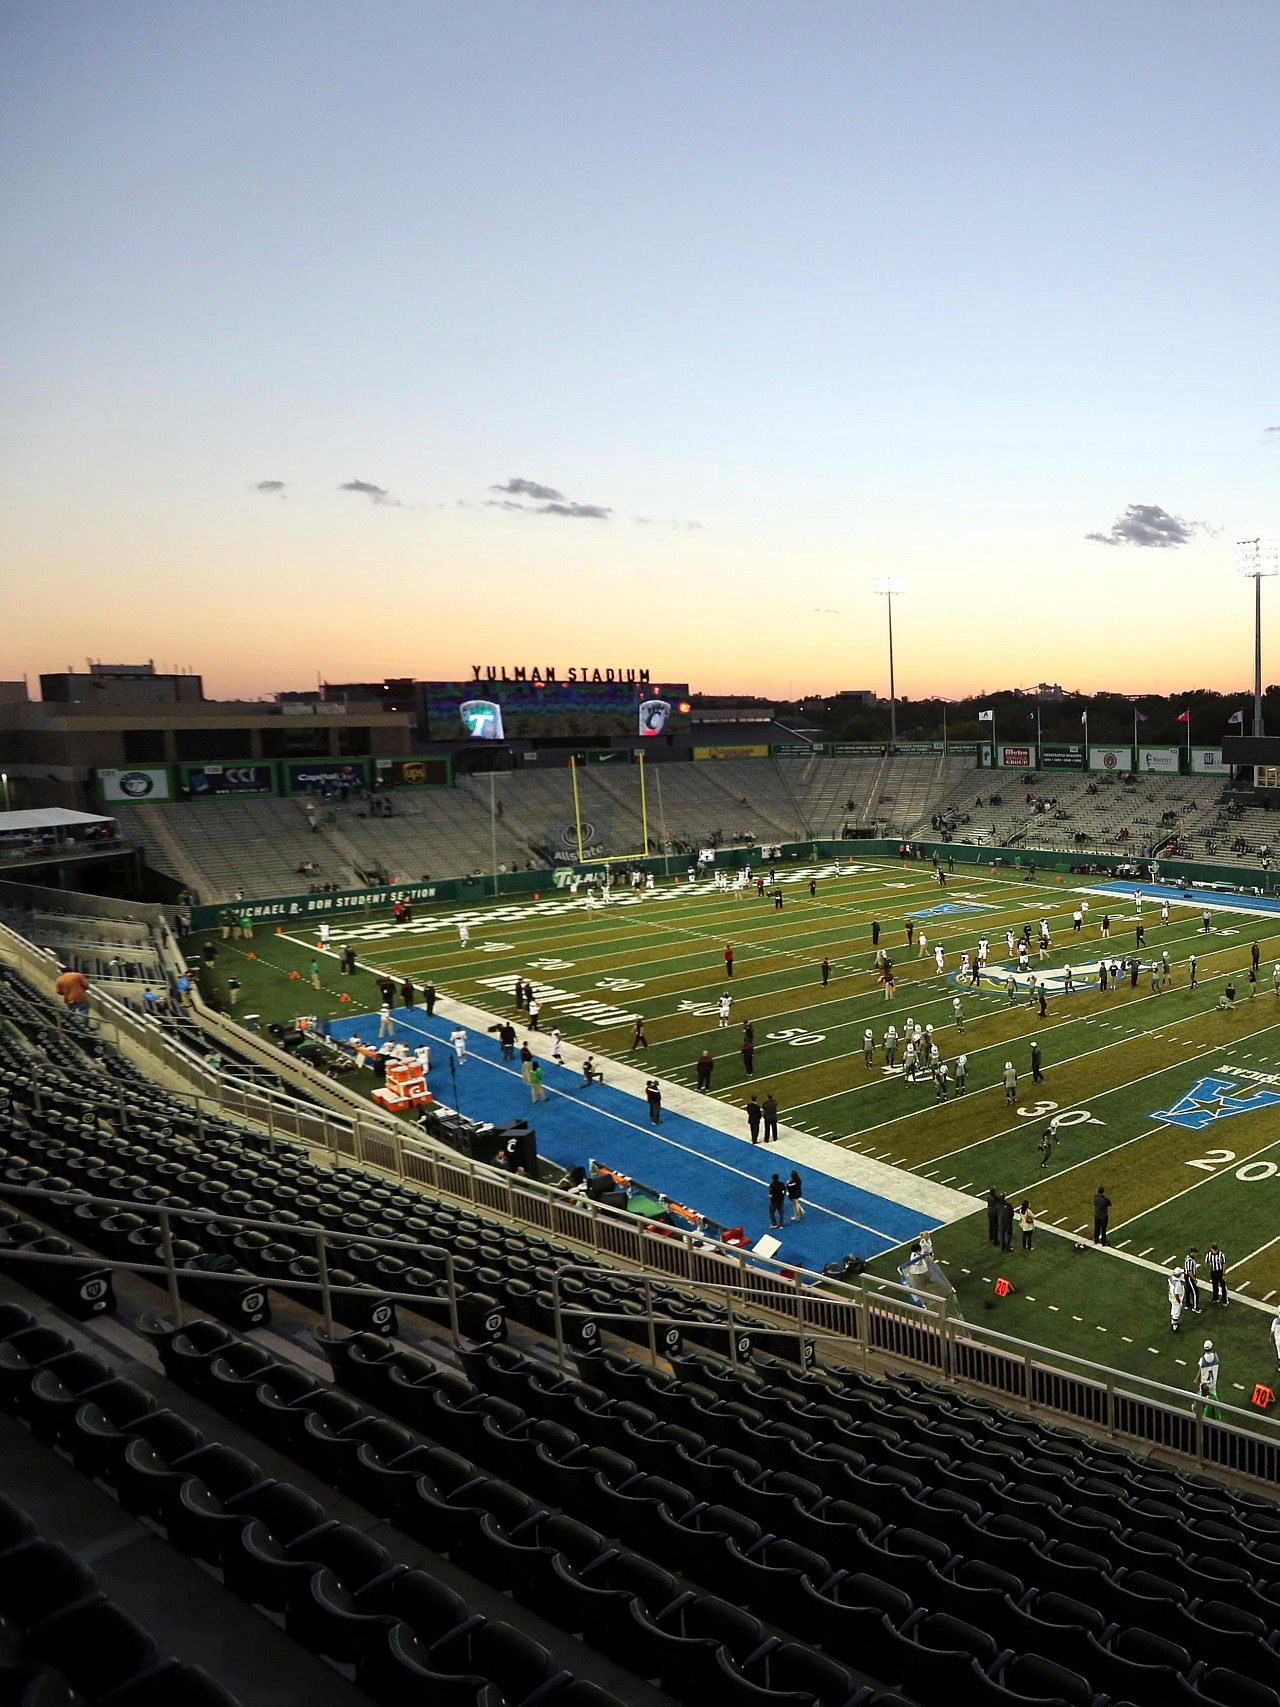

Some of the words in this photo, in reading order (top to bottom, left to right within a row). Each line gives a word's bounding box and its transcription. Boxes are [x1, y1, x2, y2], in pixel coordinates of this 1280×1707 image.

[472, 665, 556, 682] YULMAN
[568, 667, 650, 684] STADIUM
[1005, 748, 1028, 756] Metro
[554, 844, 604, 861] Allsate
[307, 899, 332, 911] BOH
[335, 893, 387, 908] STUDENT
[389, 887, 436, 902] SETION
[474, 941, 515, 952] 10
[526, 957, 575, 971] 20
[595, 977, 646, 992] 30
[766, 1027, 826, 1046] 50
[1016, 1100, 1092, 1127] 30
[1183, 1149, 1278, 1181] 20
[996, 1280, 1007, 1295] 20
[1255, 1388, 1267, 1405] 10
